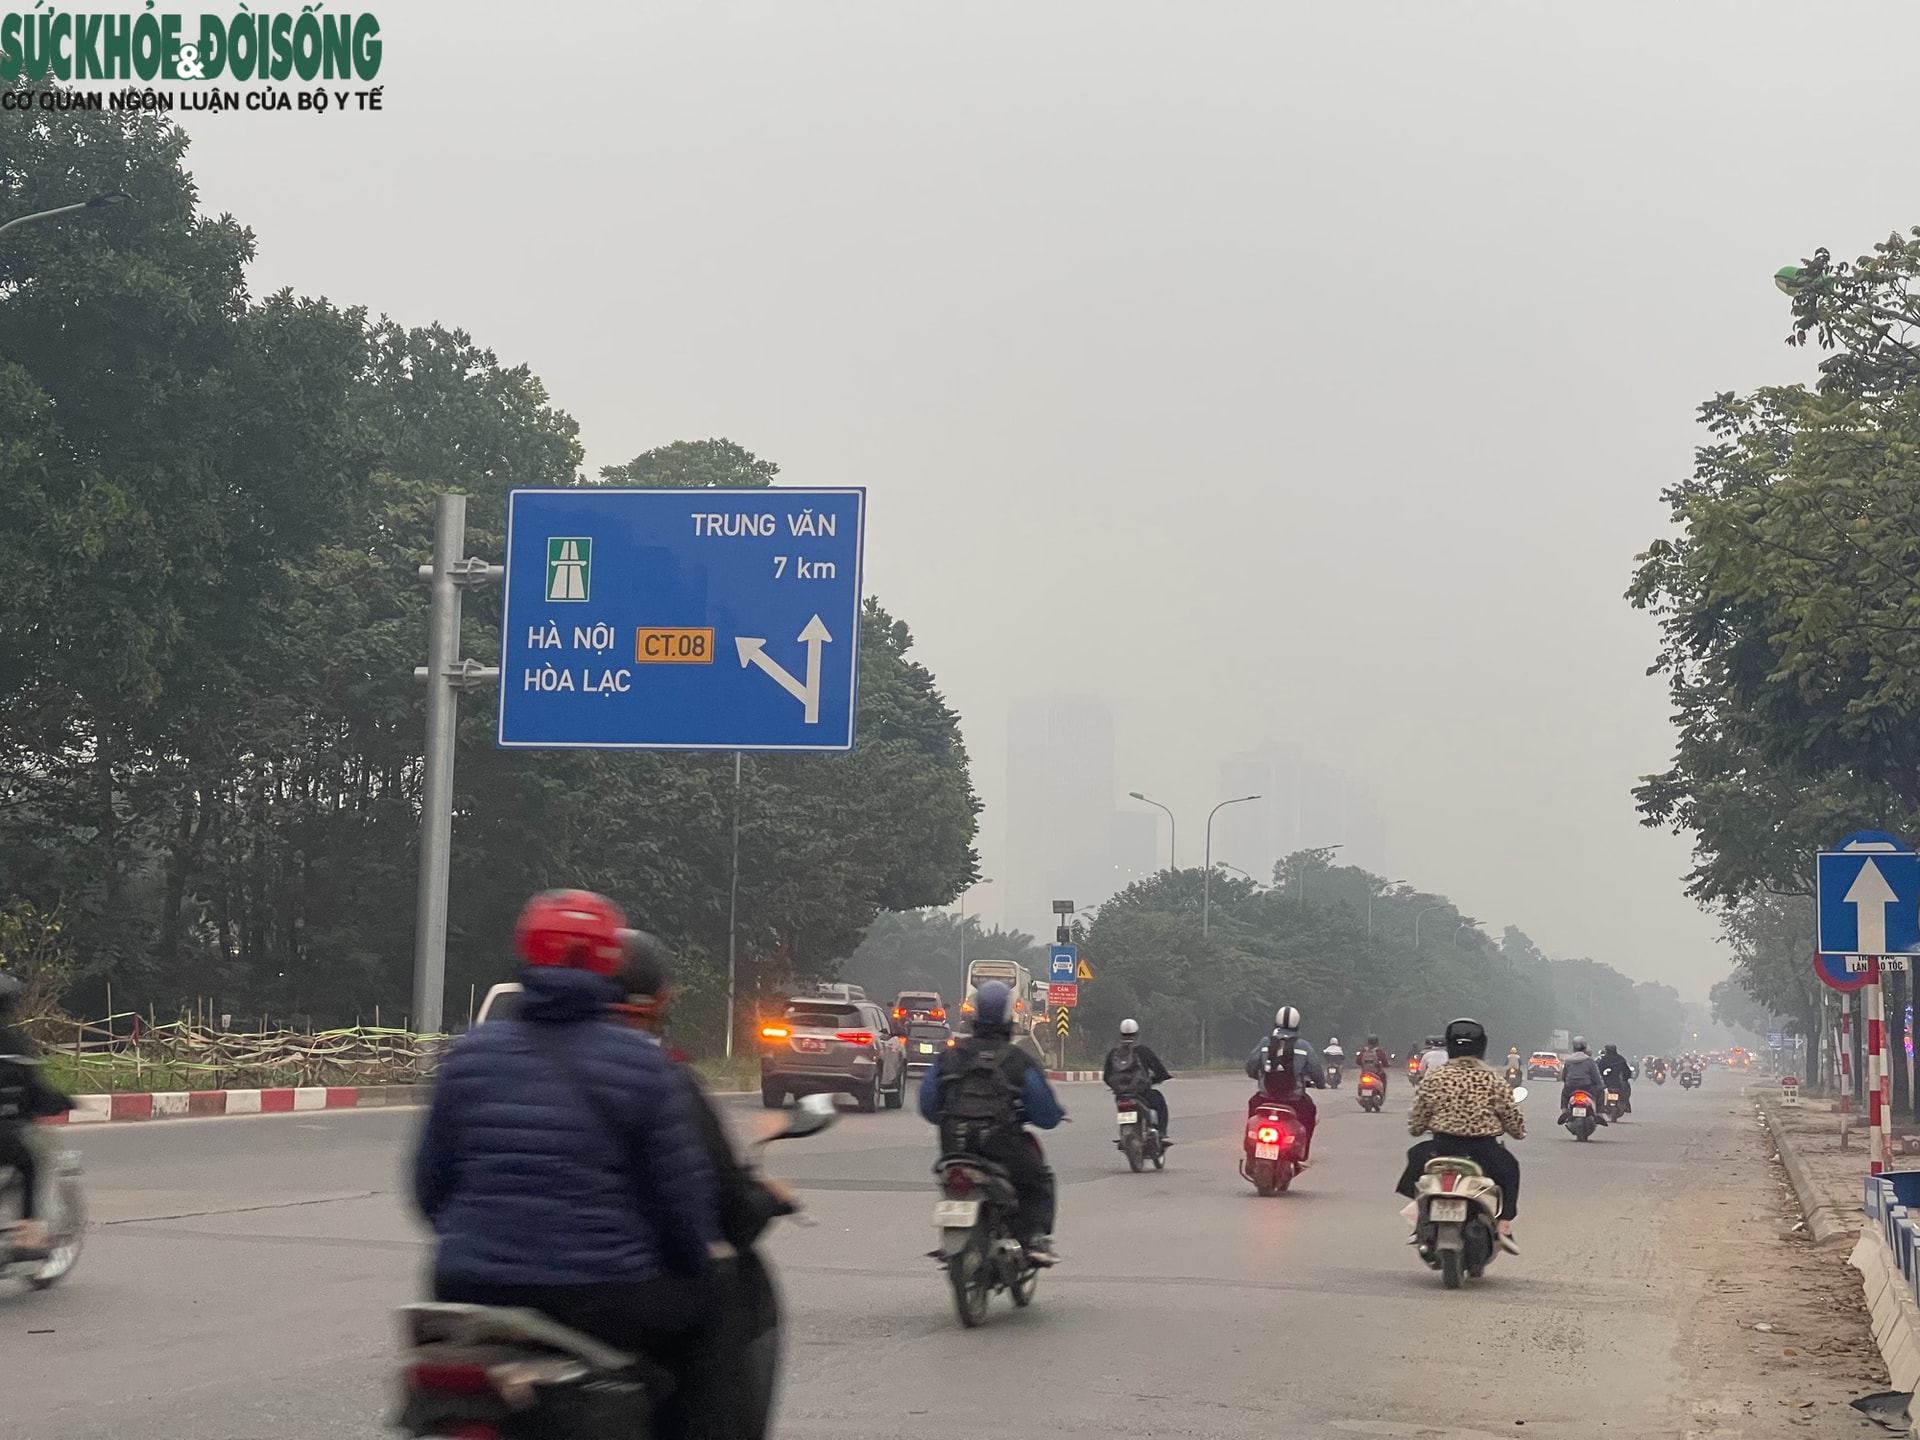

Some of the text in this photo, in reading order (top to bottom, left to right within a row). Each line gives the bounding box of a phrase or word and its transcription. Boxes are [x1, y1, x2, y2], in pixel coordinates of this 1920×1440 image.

[691, 509, 836, 537] TRUNG VĂN
[773, 556, 836, 579] 7 km
[527, 620, 614, 655] HÀ NỘI
[644, 634, 705, 657] CT.08
[524, 663, 631, 697] HÒA LẠC
